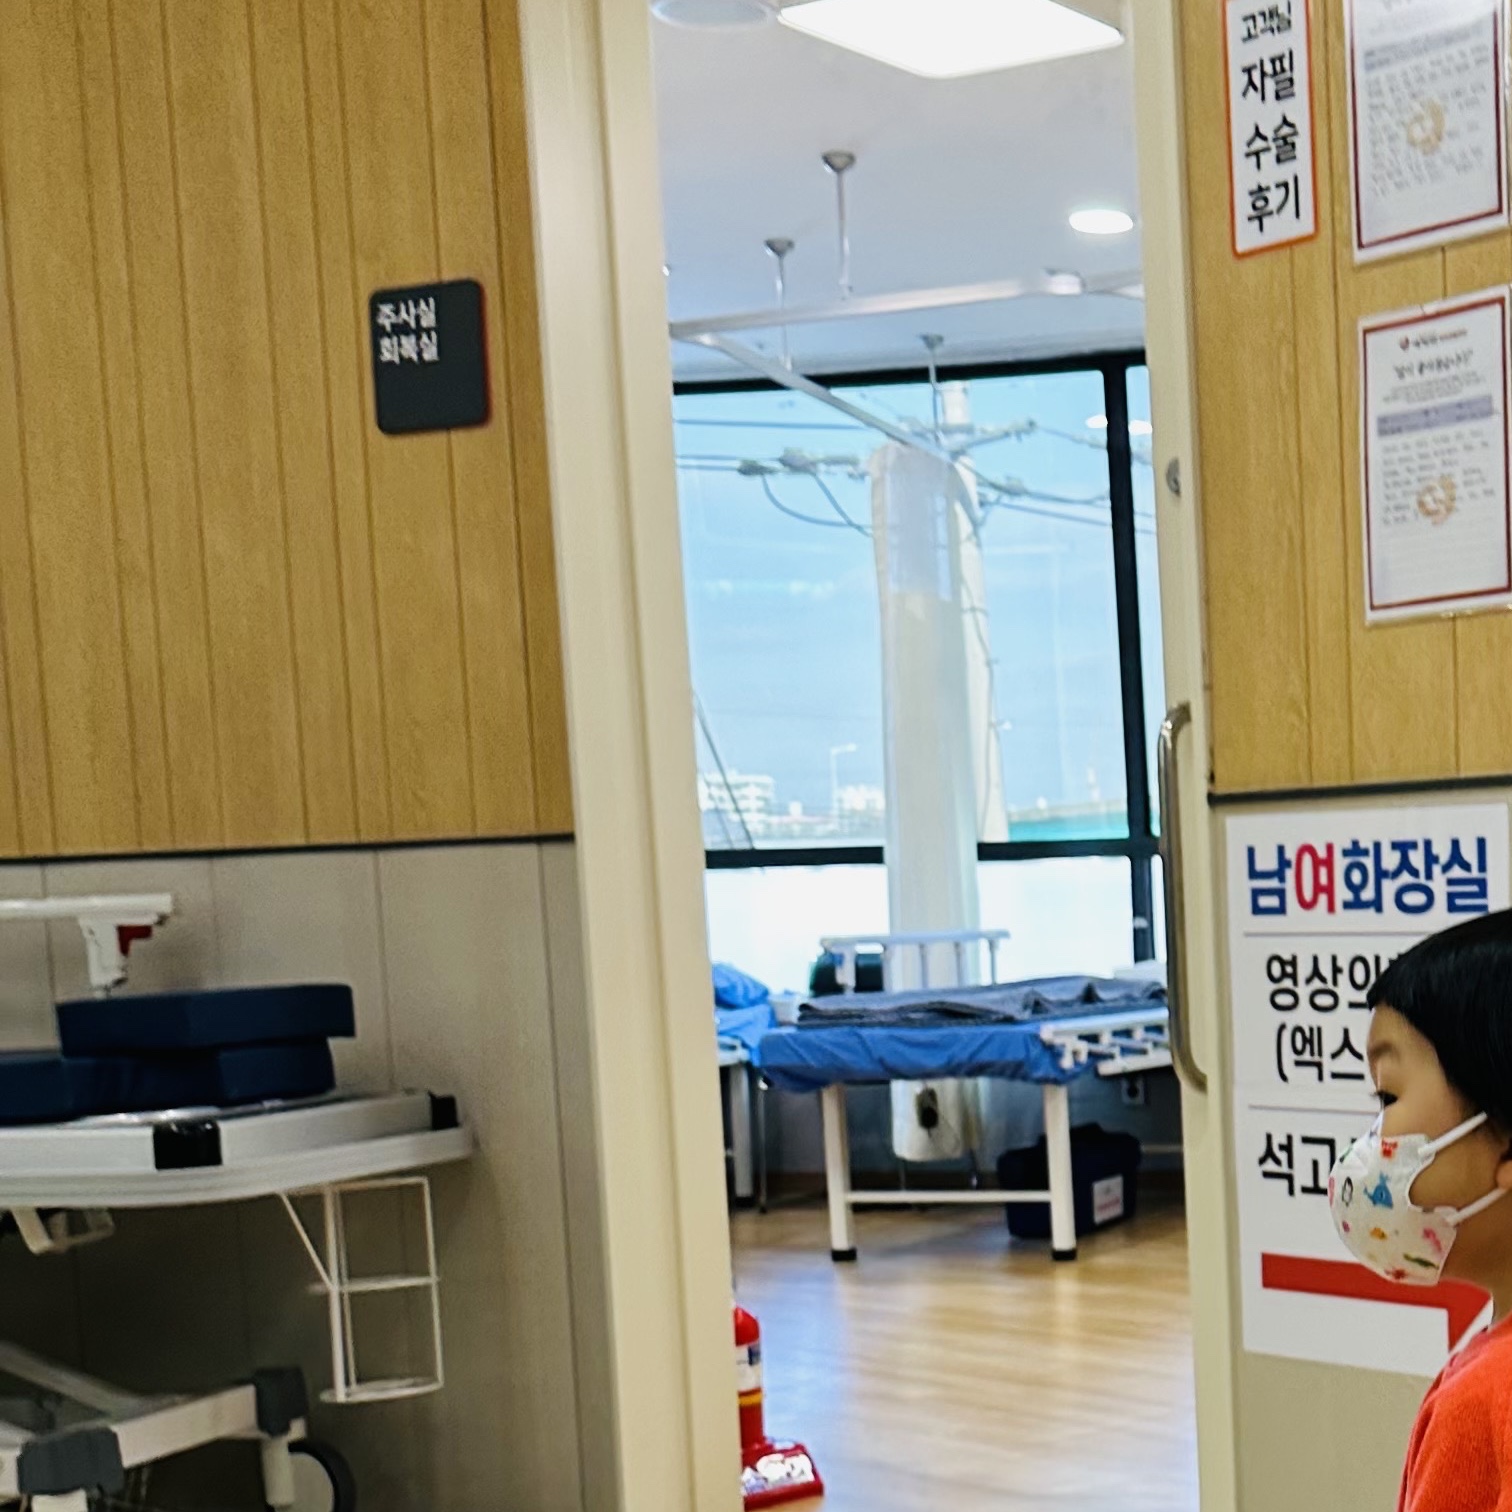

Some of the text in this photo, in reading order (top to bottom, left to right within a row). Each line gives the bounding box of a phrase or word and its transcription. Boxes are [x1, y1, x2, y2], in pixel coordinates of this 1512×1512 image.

[1241, 0, 1293, 43] 고객님
[1241, 48, 1296, 104] 자필
[1244, 112, 1299, 172] 수술
[1247, 173, 1300, 233] 후기
[1247, 836, 1490, 917] 남여화장실
[1266, 953, 1401, 1013] 영상의
